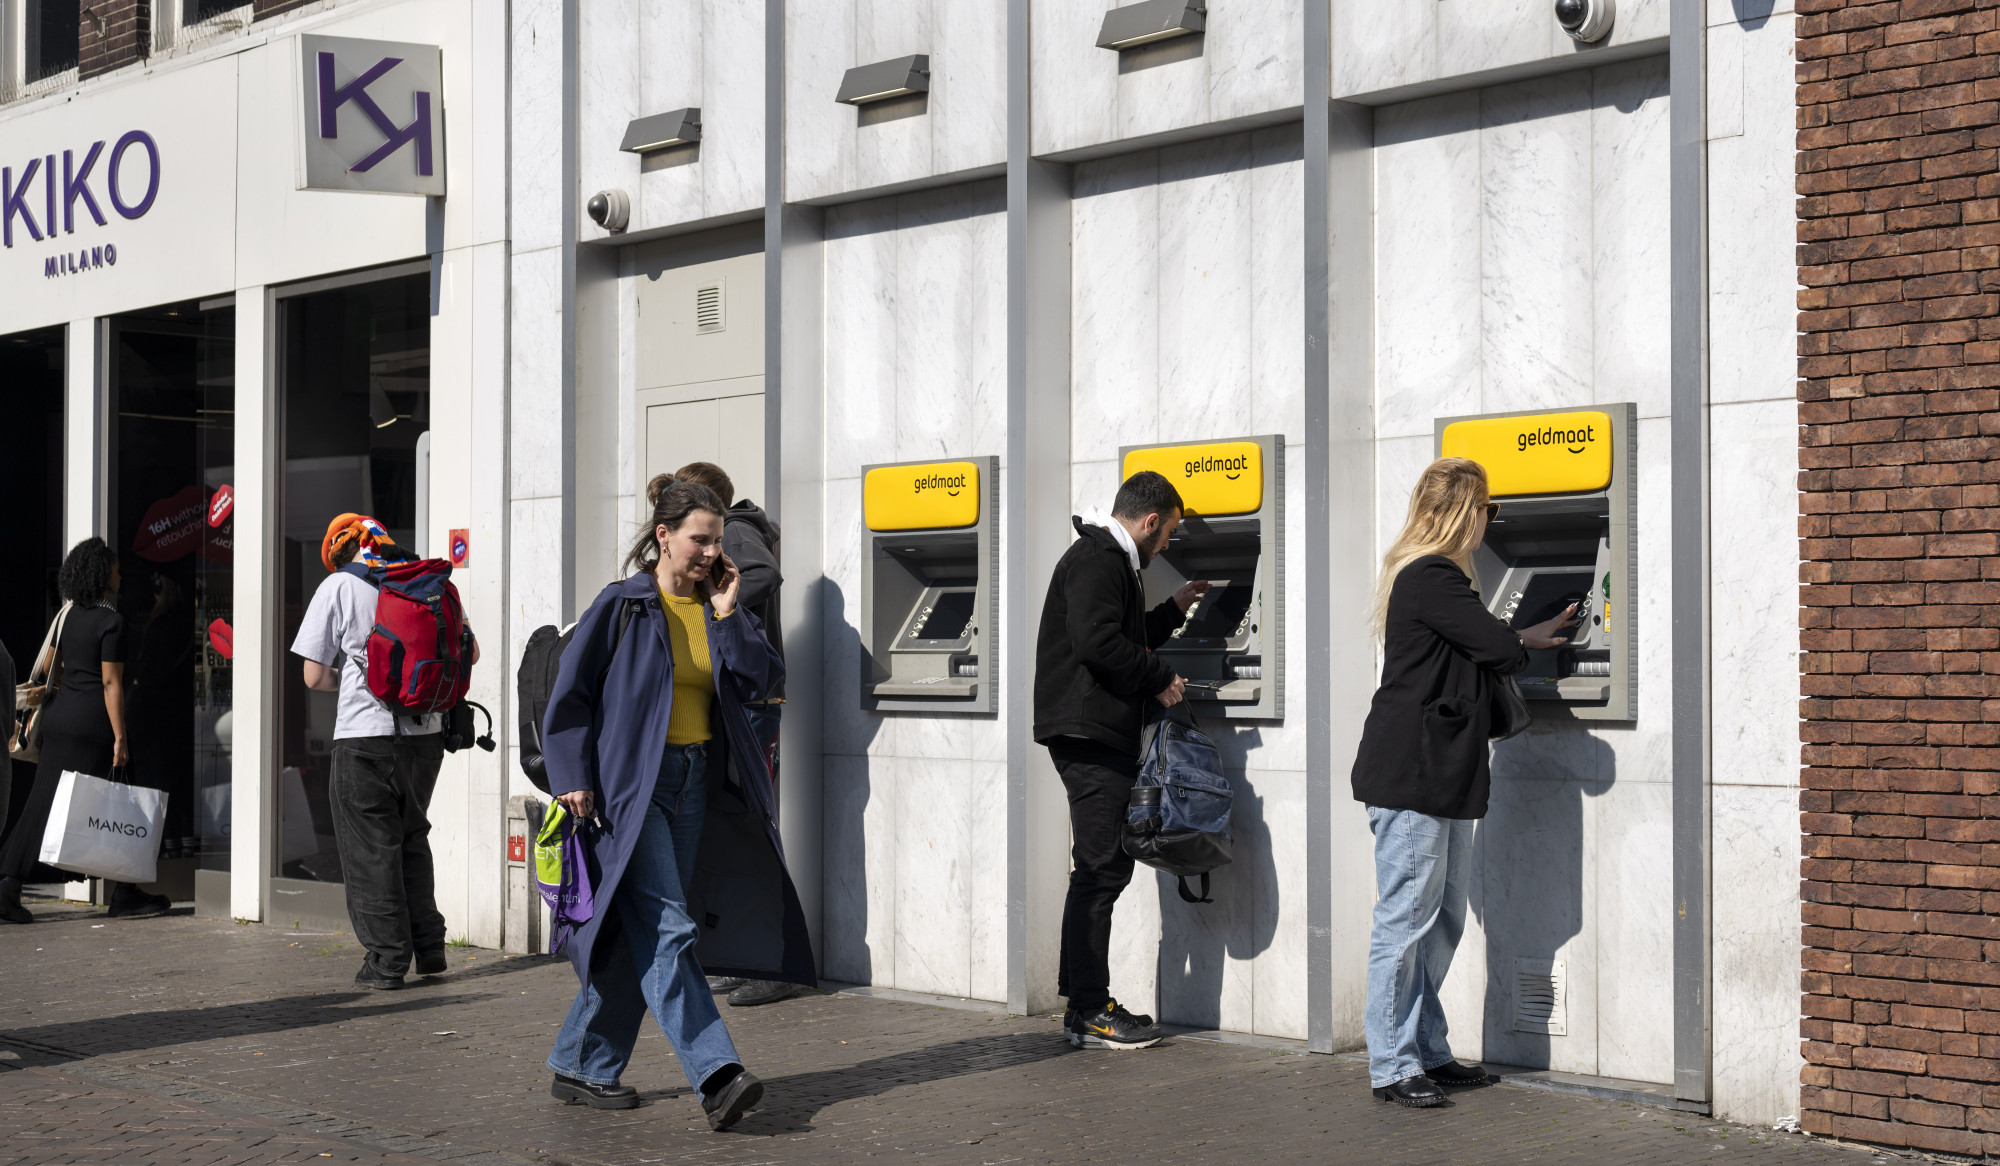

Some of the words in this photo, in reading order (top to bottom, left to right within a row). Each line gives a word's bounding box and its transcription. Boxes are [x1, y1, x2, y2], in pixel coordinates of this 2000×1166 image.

[2, 130, 160, 248] KIKO
[45, 244, 117, 279] MILANO
[1517, 425, 1595, 451] geldmaat
[1184, 454, 1248, 478] geldmaat
[914, 473, 966, 494] geldmaat
[148, 516, 172, 536] 16H
[88, 816, 148, 838] MANGO
